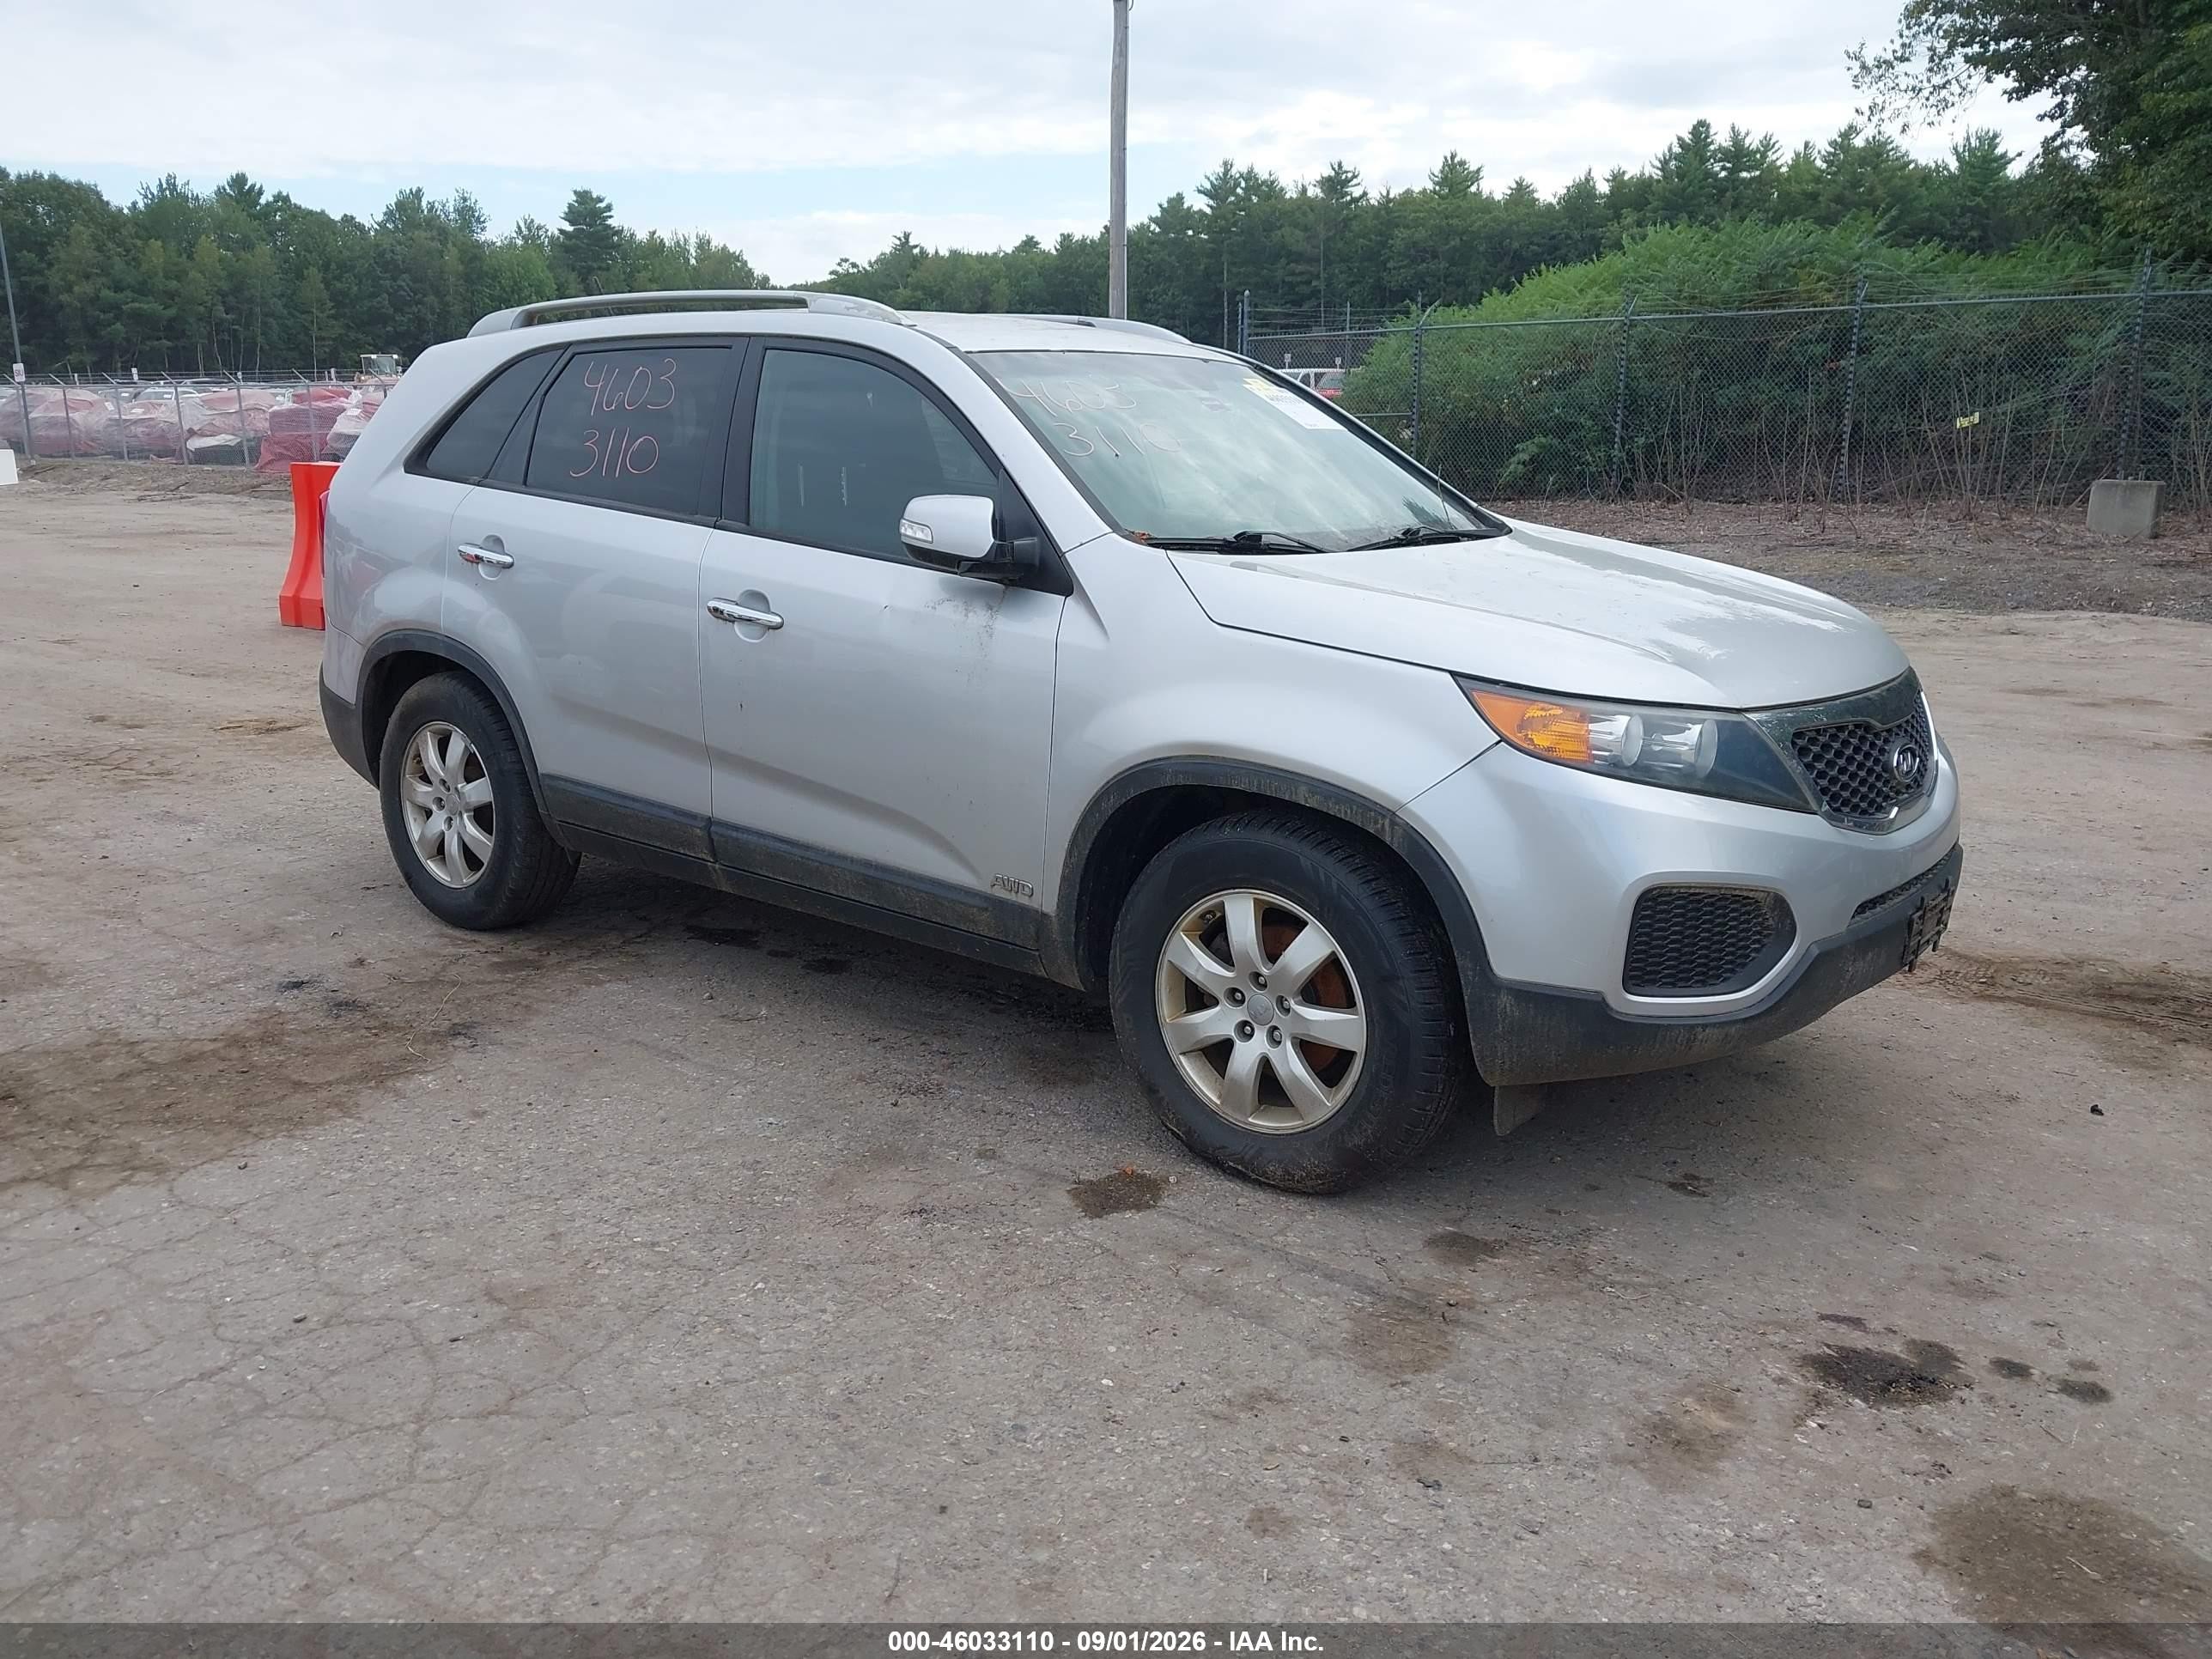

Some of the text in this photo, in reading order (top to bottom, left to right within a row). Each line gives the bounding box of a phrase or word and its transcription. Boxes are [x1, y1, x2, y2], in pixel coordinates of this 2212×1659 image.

[583, 358, 677, 416] 4603
[994, 379, 1138, 417] 4603
[569, 427, 659, 478] 3110
[1053, 422, 1182, 458] 3110
[990, 873, 1034, 898] AWD
